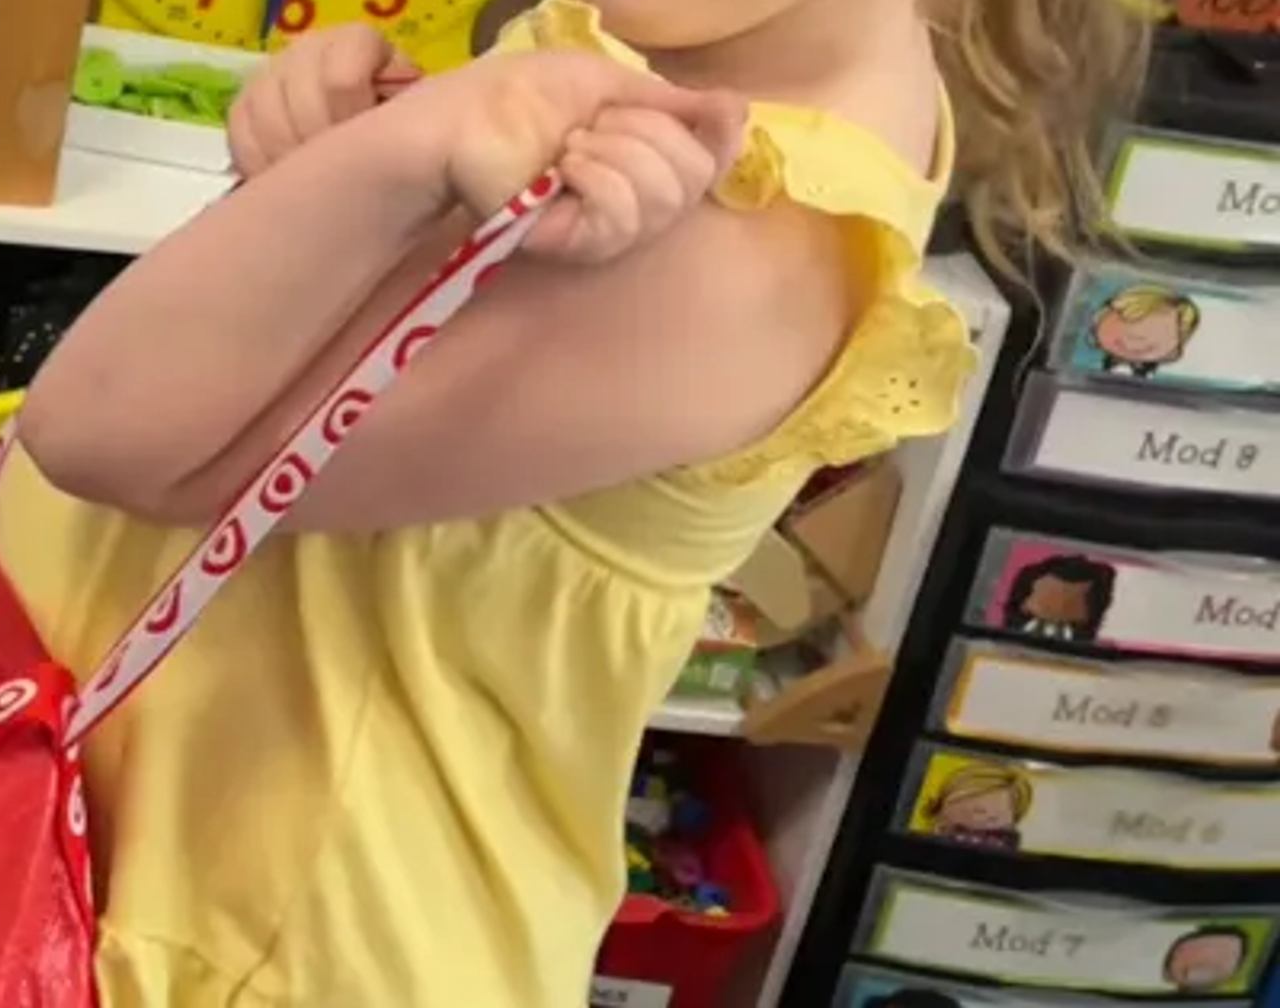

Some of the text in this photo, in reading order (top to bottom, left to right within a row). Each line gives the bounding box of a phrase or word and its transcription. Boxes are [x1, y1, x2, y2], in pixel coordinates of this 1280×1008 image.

[1136, 430, 1259, 472] Mod 8
[1194, 594, 1280, 630] Mod
[1051, 694, 1139, 728] Mod
[1109, 809, 1193, 844] Mod
[968, 921, 1087, 958] Mod 7
